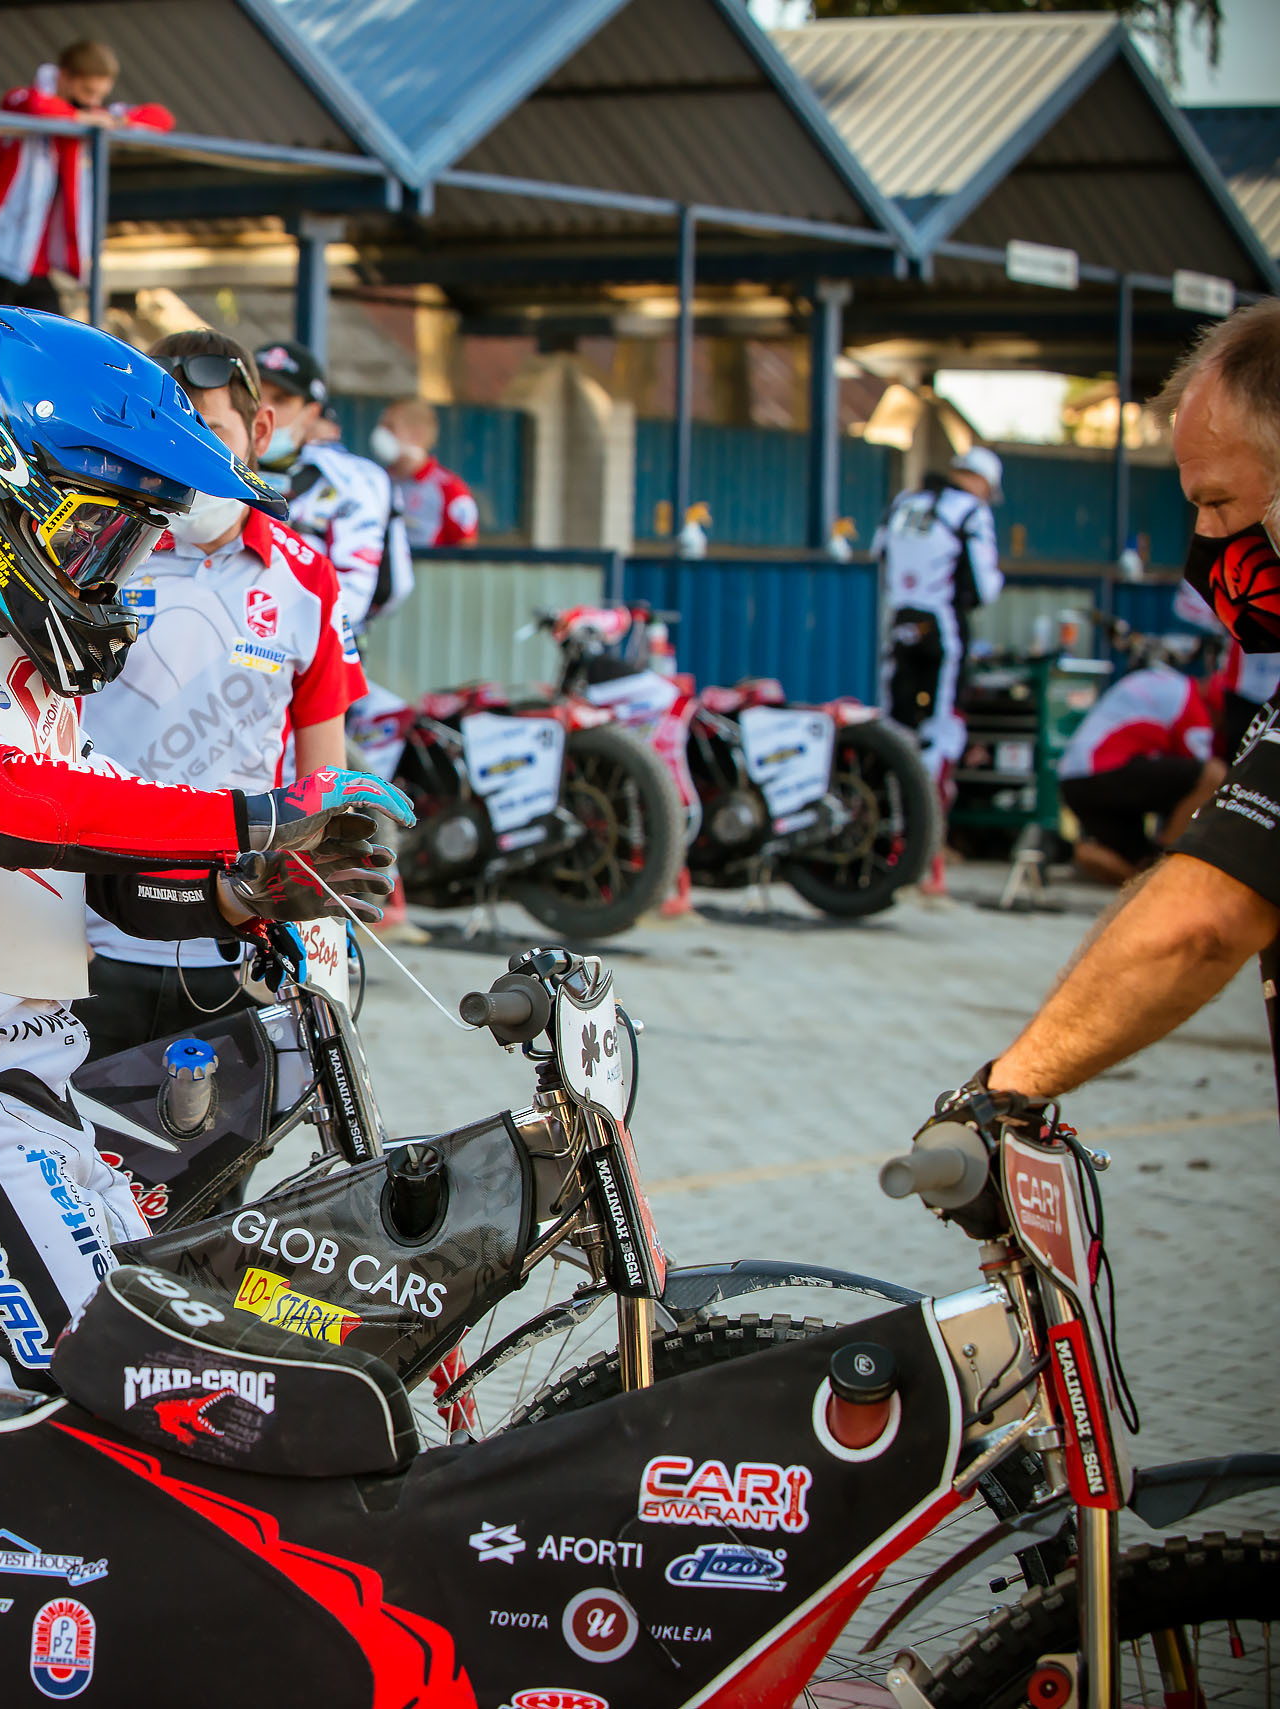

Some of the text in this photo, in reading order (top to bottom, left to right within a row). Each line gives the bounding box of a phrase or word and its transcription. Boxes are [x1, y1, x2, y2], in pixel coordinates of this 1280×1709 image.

[46, 500, 74, 534] OAKLEY
[26, 1149, 110, 1283] ellfast
[232, 1210, 448, 1318] GLOB CARS
[137, 1274, 225, 1327] 98
[124, 1366, 276, 1415] MAD-CROC
[646, 1462, 779, 1506] CAR
[644, 1501, 779, 1526] GWARANT
[32, 1555, 83, 1570] HOUSE
[537, 1535, 643, 1568] AFORTI
[60, 1620, 70, 1636] P
[489, 1610, 549, 1629] TOYOTA
[650, 1625, 712, 1642] UKLEJA
